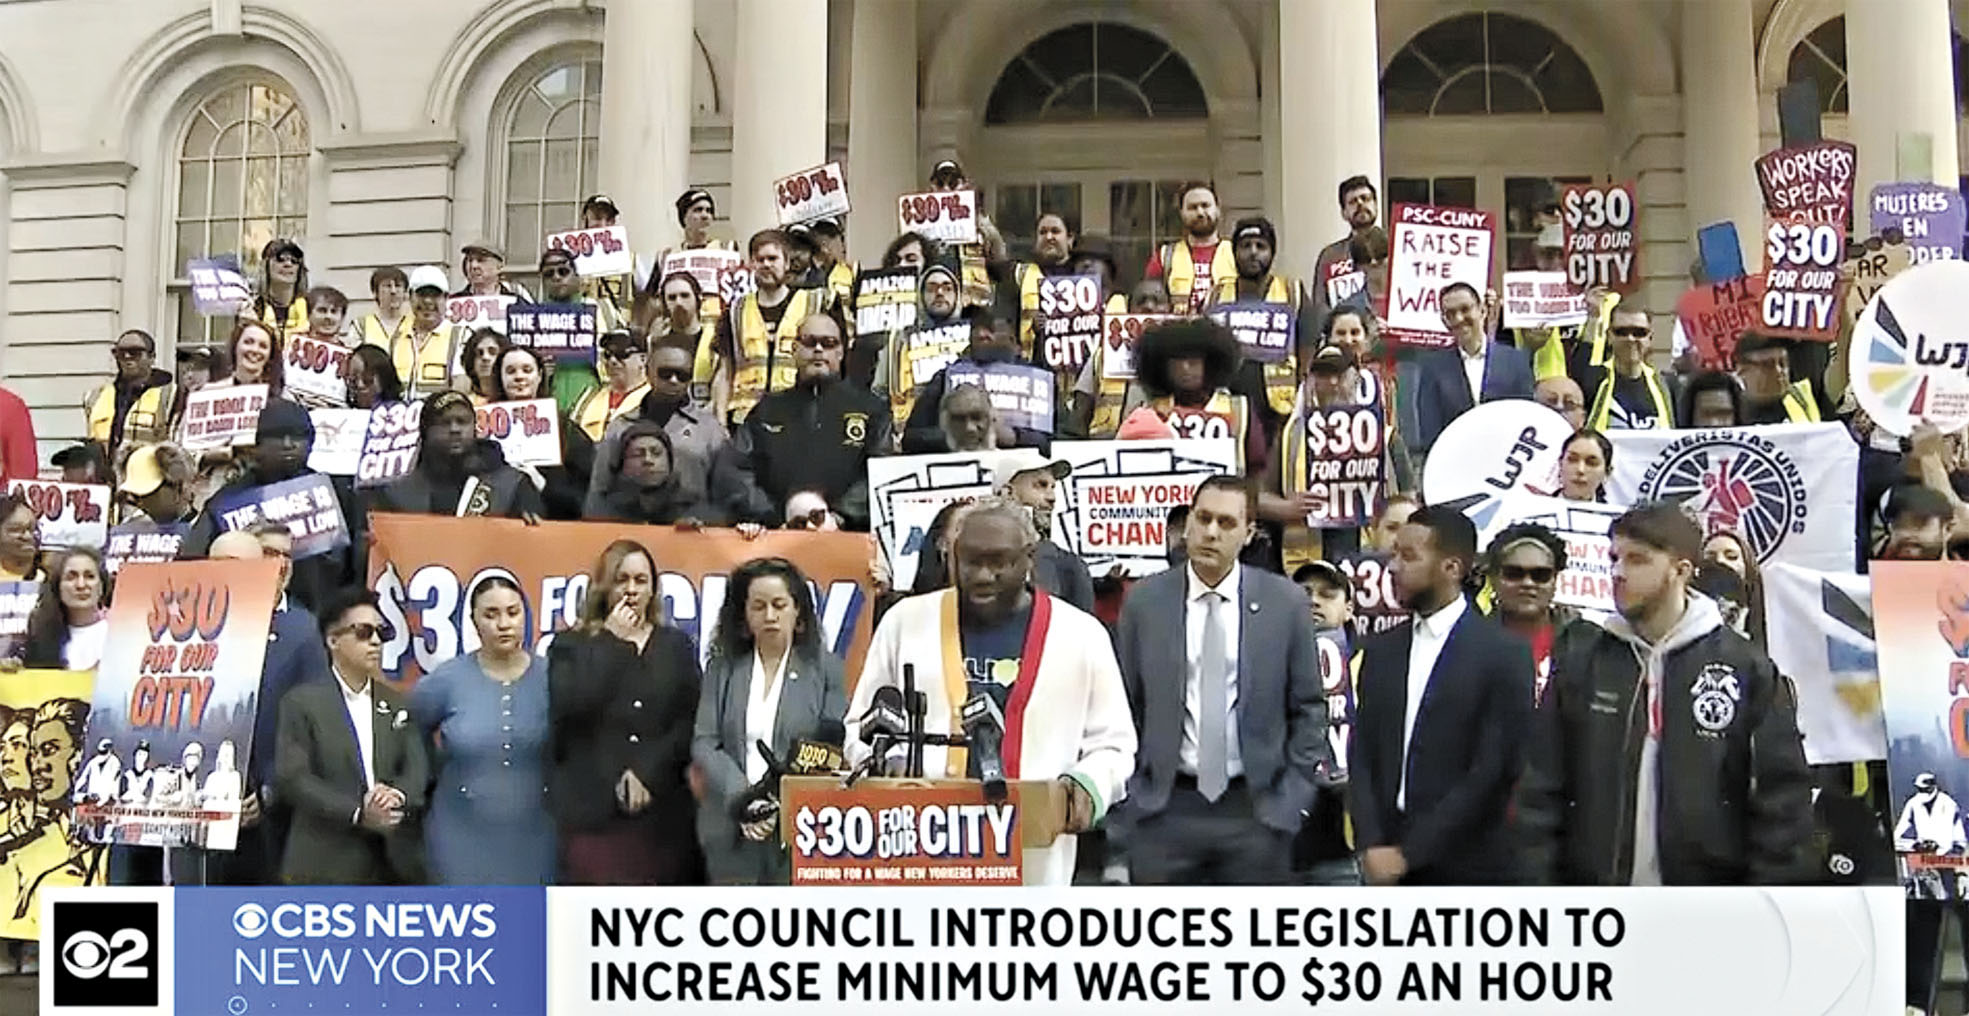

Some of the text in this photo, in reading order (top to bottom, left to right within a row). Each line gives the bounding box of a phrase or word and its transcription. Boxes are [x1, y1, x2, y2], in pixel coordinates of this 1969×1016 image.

[1565, 188, 1630, 229] $30
[1775, 180, 1848, 209] SPEAK
[1875, 192, 1949, 214] MUJERES
[1403, 207, 1486, 227] PSC-CUNY
[1903, 217, 1928, 237] EN
[1402, 230, 1480, 257] RAISE
[1568, 231, 1632, 252] FOR OUR
[1767, 222, 1838, 265] $30
[1412, 261, 1453, 279] THE
[1568, 253, 1633, 285] CITY
[1767, 270, 1835, 290] FOR OUR
[448, 299, 477, 323] 30
[1040, 278, 1097, 316] $30
[1398, 287, 1440, 313] WA
[1763, 290, 1833, 329] CITY
[511, 313, 594, 331] THE WAGE IS
[1045, 315, 1100, 335] FOR OUR
[1230, 311, 1270, 330] WAGE
[1272, 313, 1288, 330] IS
[1044, 333, 1101, 366] CITY
[1916, 334, 1969, 377] WJ
[369, 400, 425, 436] $30
[476, 407, 511, 439] 30
[1308, 409, 1377, 456] $30
[359, 446, 418, 480] CITY
[1310, 457, 1379, 481] FOR OUR
[1088, 485, 1136, 505] NEW
[1638, 430, 1807, 533] DELIVERISTAS UNIDOS
[261, 489, 312, 520] WAGE
[313, 484, 332, 508] IS
[1089, 506, 1172, 520] COMMUNIT
[1310, 481, 1379, 520] CITY
[311, 508, 338, 533] LOW
[1088, 522, 1163, 546] CHAN
[136, 533, 182, 554] WAGE
[540, 574, 590, 632] FO
[140, 643, 219, 675] FOR OUR
[131, 676, 216, 730] CITY
[796, 805, 1016, 859] $30 FOR OUR CITY
[797, 867, 842, 880] FIGHTING
[844, 867, 862, 880] FOR
[864, 867, 872, 880] A
[875, 867, 901, 880] WAGE
[903, 867, 926, 880] NEW
[928, 867, 972, 880] YORKERS
